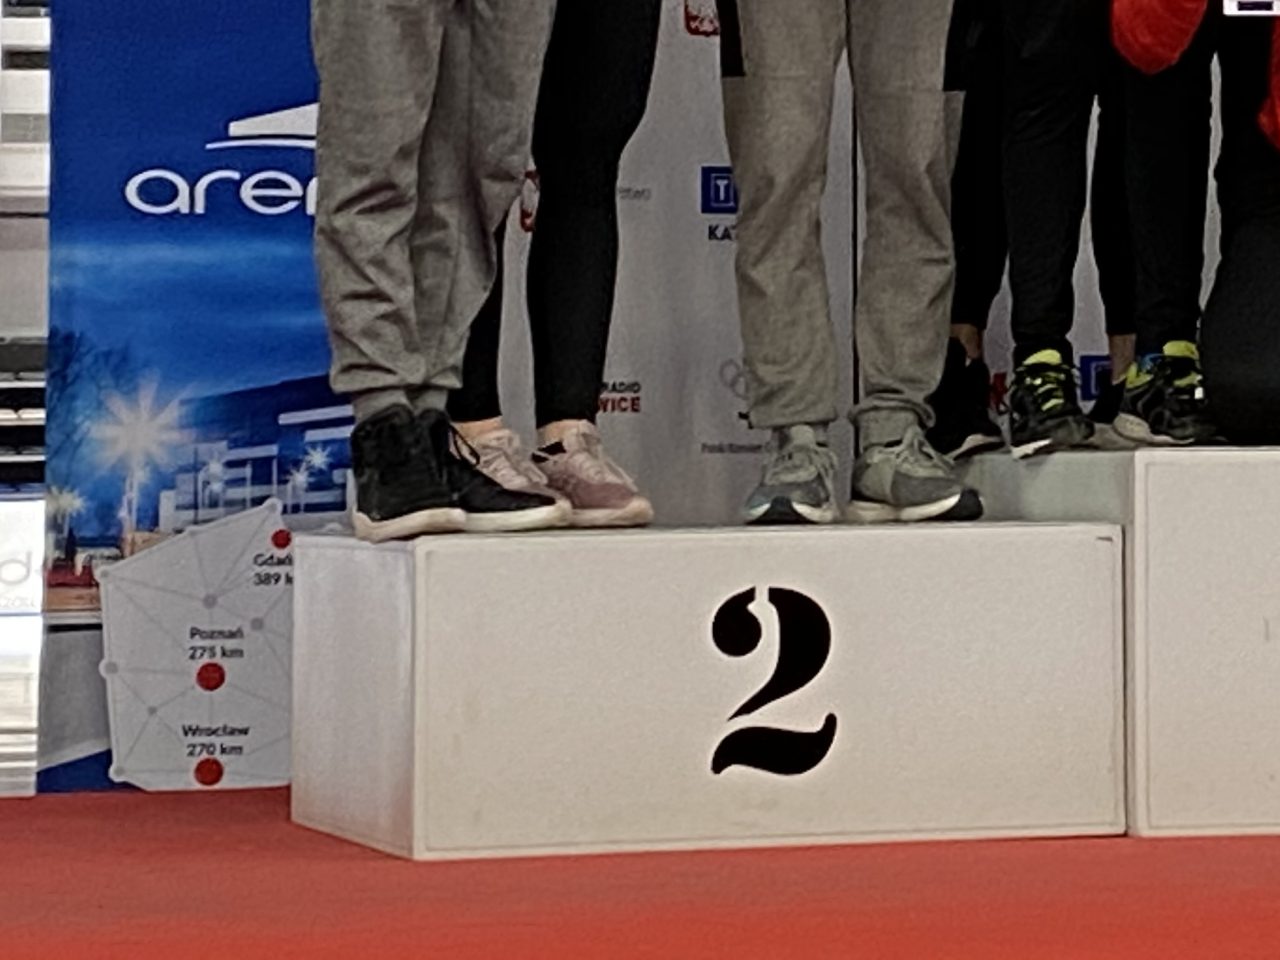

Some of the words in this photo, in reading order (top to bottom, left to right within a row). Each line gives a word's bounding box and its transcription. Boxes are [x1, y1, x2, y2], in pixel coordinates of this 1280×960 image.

[253, 572, 281, 586] 389
[190, 626, 243, 640] Poznań
[188, 646, 216, 659] 275
[220, 646, 244, 659] km
[711, 587, 837, 776] 2
[186, 743, 215, 757] 270
[219, 743, 243, 756] km
